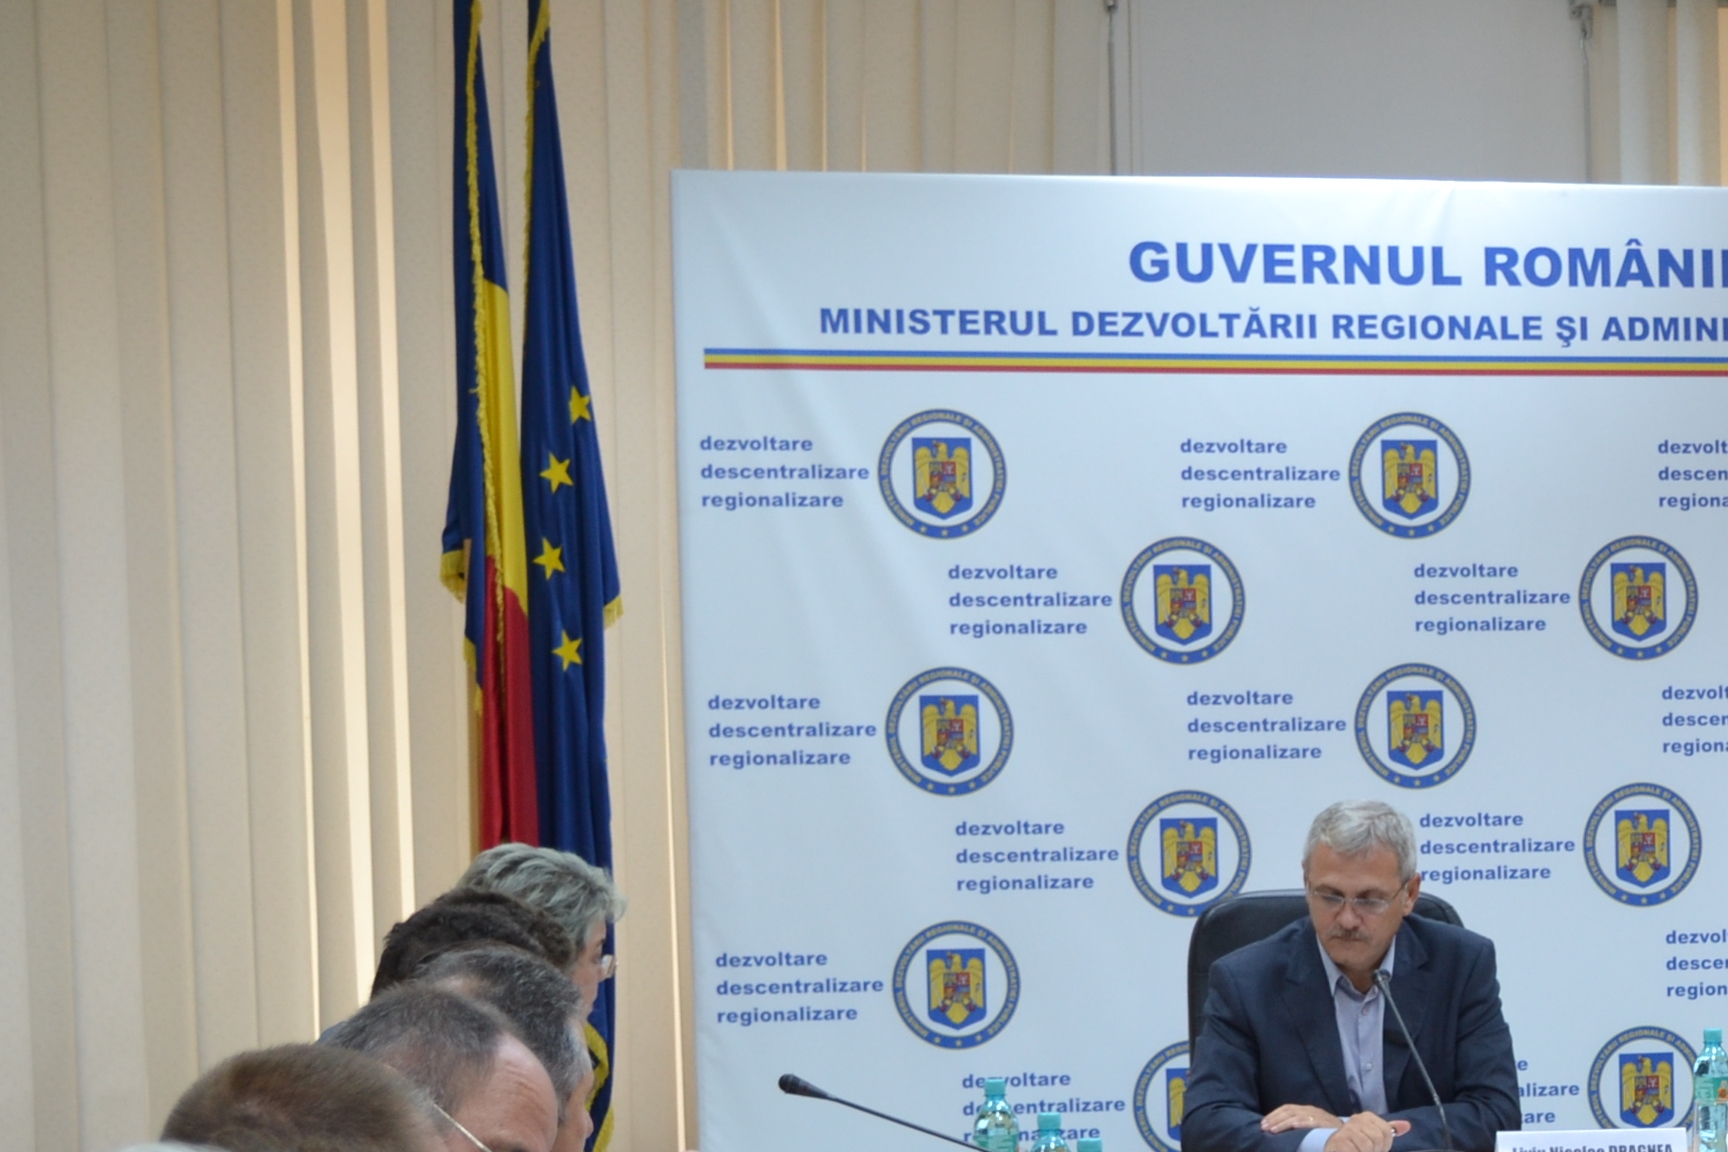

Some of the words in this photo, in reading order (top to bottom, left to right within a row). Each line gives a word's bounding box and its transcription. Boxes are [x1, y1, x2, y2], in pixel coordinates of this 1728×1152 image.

[1129, 241, 1462, 286] GUVERNUL
[820, 308, 1058, 336] MINISTERUL
[1072, 307, 1317, 339] DEZVOLTĂRII
[1332, 314, 1543, 340] REGIONALE
[700, 436, 813, 451] dezvoltare
[1180, 439, 1287, 453] dezvoltare
[701, 464, 869, 479] descentralizare
[1181, 466, 1340, 481] descentralizare
[702, 492, 843, 511] regionalizare
[1182, 493, 1316, 512] regionalizare
[948, 565, 1058, 579] dezvoltare
[1414, 563, 1518, 578] dezvoltare
[949, 592, 1112, 607] descentralizare
[1415, 590, 1571, 605] descentralizare
[950, 620, 1087, 638] regionalizare
[1416, 617, 1546, 635] regionalizare
[708, 695, 820, 710] dezvoltare
[1187, 691, 1293, 705] dezvoltare
[709, 722, 876, 738] descentralizare
[1188, 717, 1346, 733] descentralizare
[710, 750, 851, 769] regionalizare
[1189, 745, 1322, 764] regionalizare
[1420, 812, 1523, 828] dezvoltare
[955, 821, 1064, 836] dezvoltare
[1420, 838, 1575, 854] descentralizare
[956, 847, 1119, 863] descentralizare
[1421, 865, 1551, 883] regionalizare
[957, 875, 1094, 894] regionalizare
[716, 952, 827, 967] dezvoltare
[716, 978, 883, 995] descentralizare
[717, 1007, 857, 1026] regionalizare
[962, 1073, 1071, 1088] devoltare
[963, 1098, 1126, 1116] dentralizare
